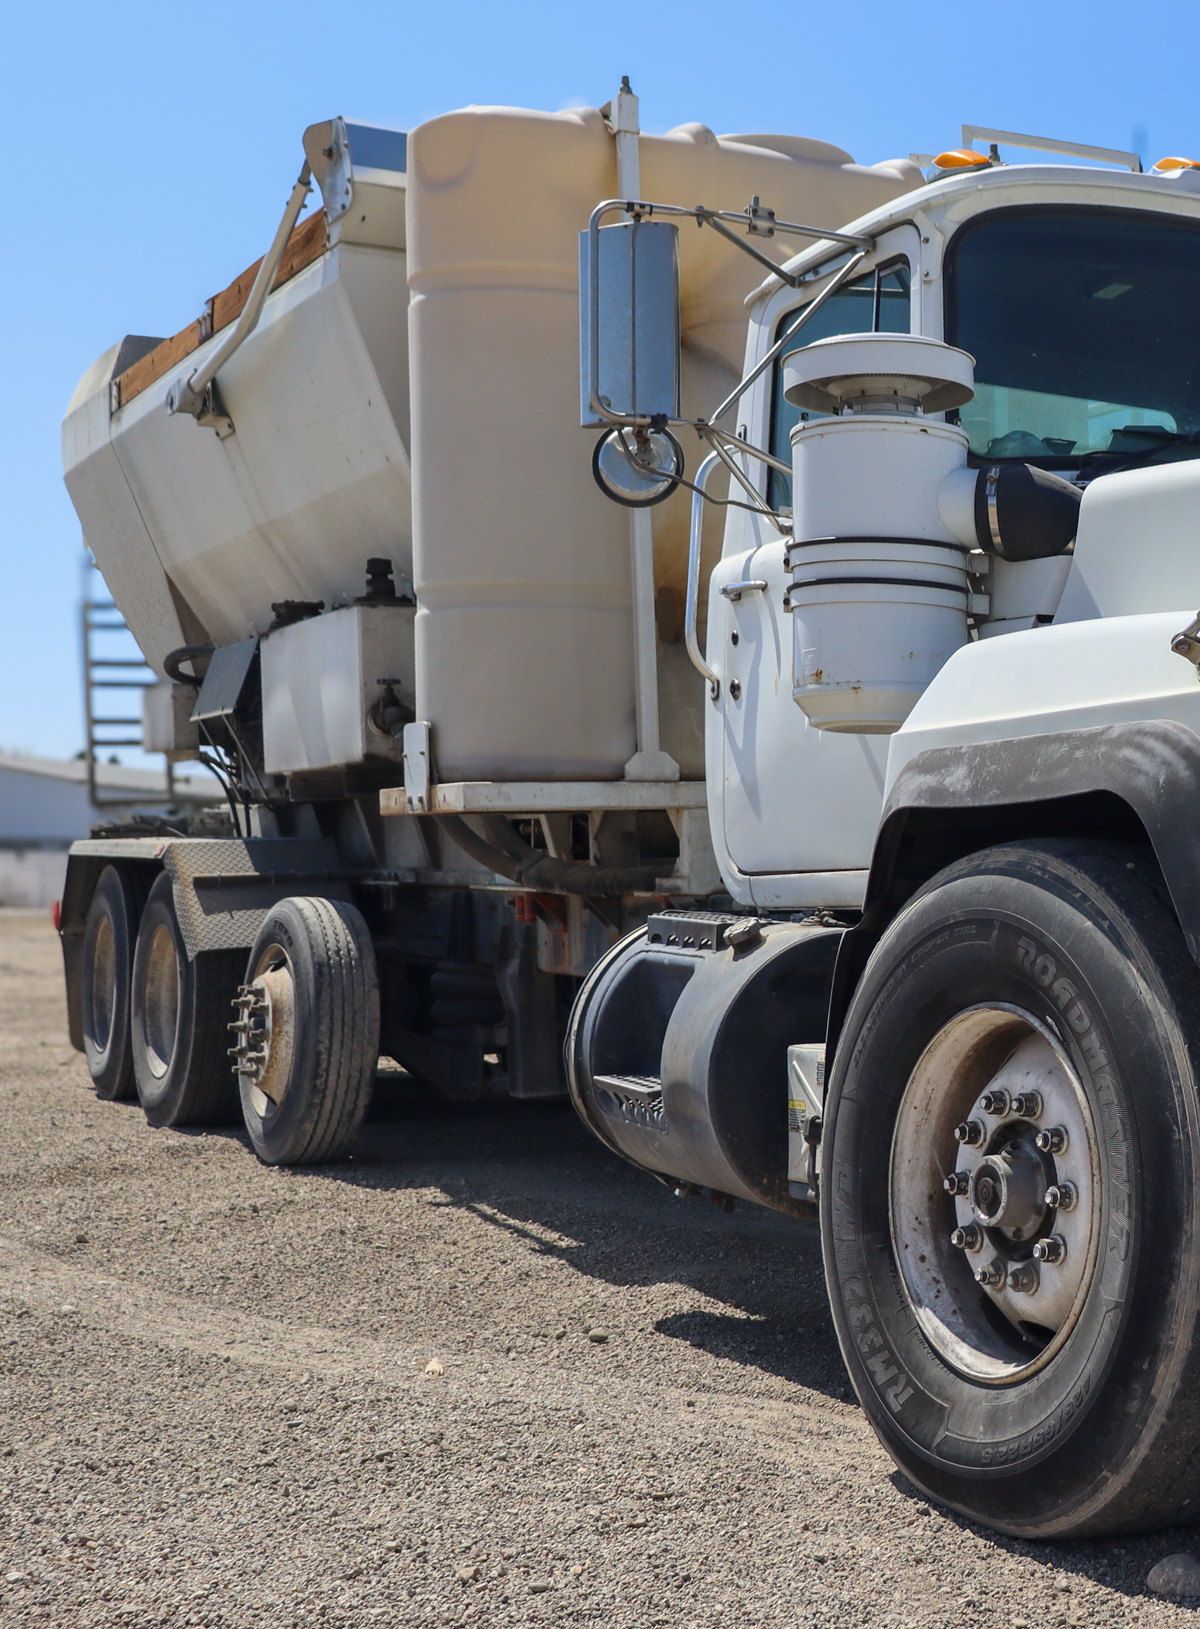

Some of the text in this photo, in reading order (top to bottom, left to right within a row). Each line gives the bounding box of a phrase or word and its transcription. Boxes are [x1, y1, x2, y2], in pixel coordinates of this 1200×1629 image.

[273, 920, 294, 947] TOYO
[911, 931, 950, 963] COOPER
[954, 925, 977, 936] TIRE
[1015, 935, 1132, 1262] ROADMASTER
[842, 1278, 914, 1413] RM332
